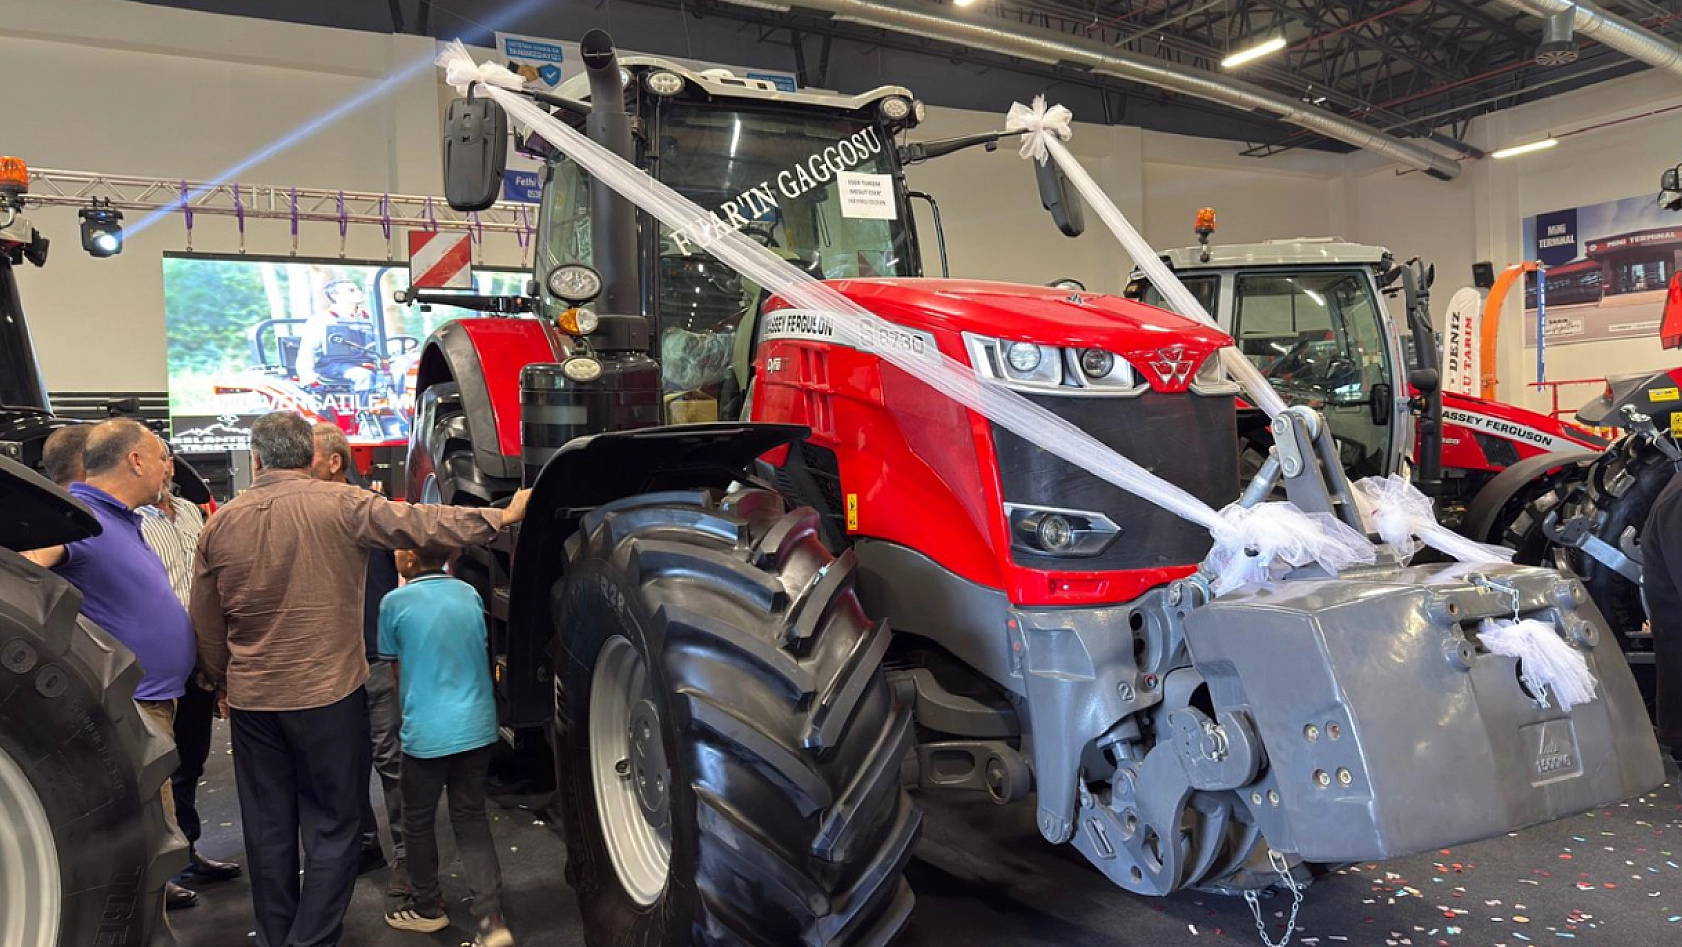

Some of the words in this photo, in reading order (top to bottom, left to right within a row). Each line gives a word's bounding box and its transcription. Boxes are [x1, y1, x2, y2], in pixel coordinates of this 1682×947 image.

[777, 126, 881, 199] GAGGOSU
[788, 315, 834, 336] FERGUSON
[1442, 410, 1483, 426] ASSEY
[1485, 420, 1553, 447] FERGUSON
